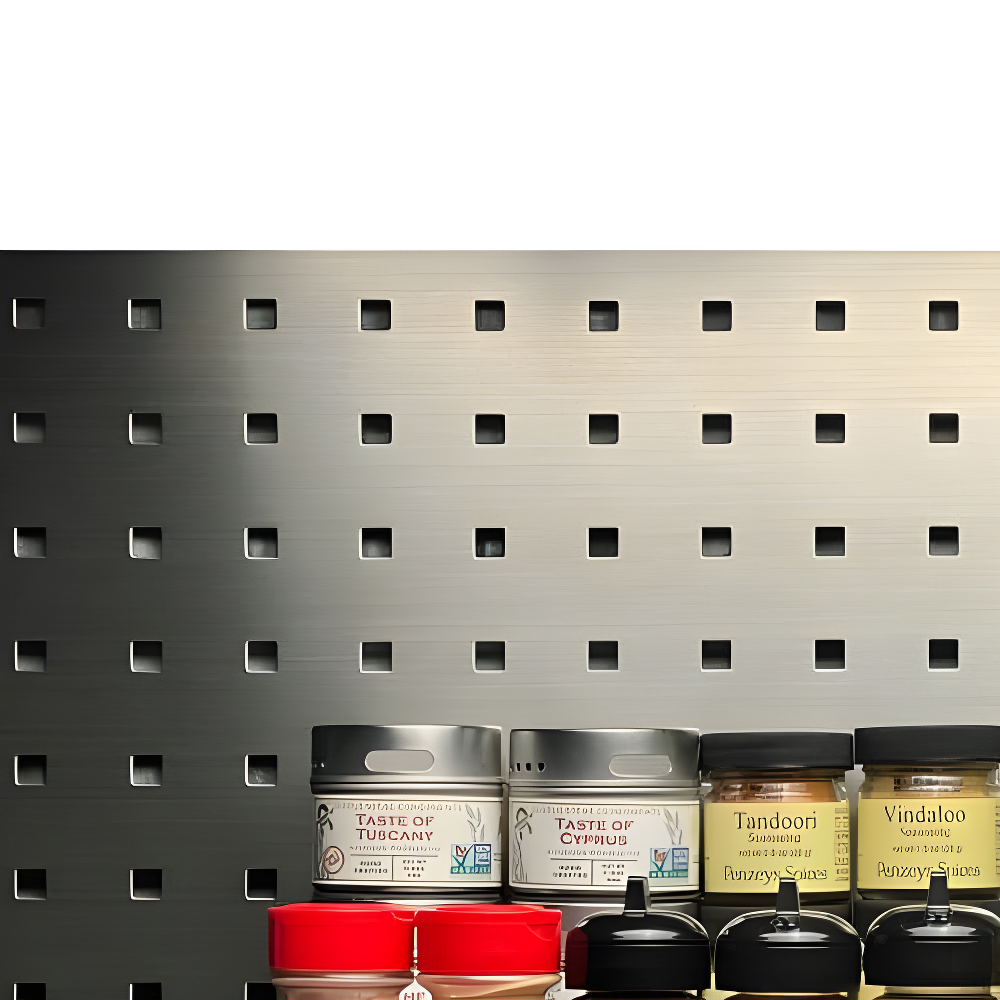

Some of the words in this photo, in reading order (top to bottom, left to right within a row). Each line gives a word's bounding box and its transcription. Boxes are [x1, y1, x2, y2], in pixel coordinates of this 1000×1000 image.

[413, 815, 435, 827] OF
[733, 810, 817, 830] Tandoori
[884, 804, 966, 823] Vindaloo
